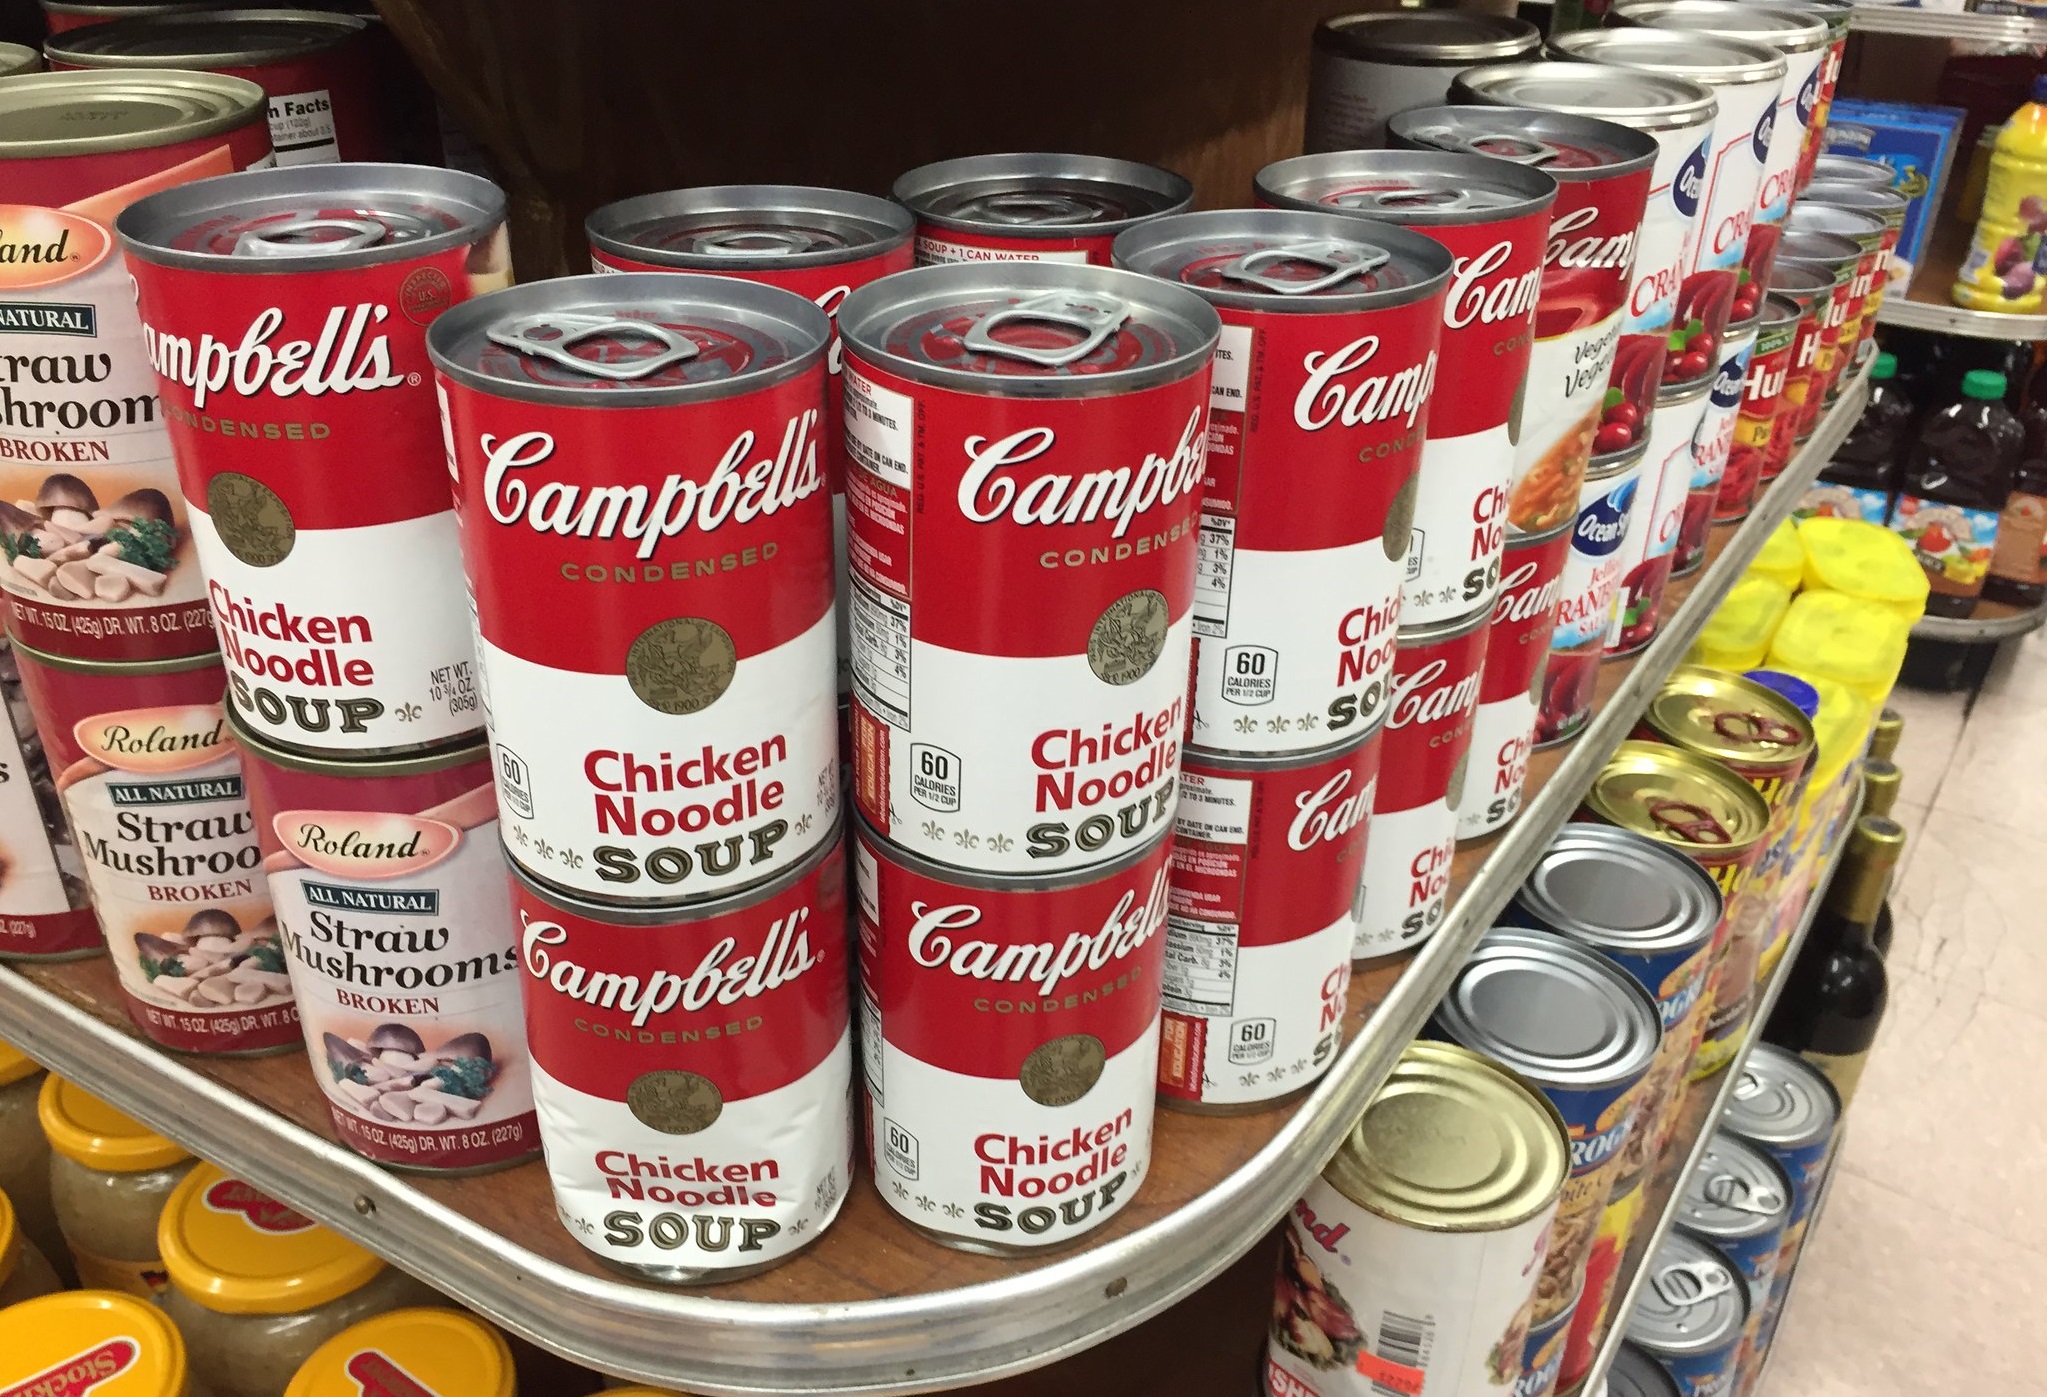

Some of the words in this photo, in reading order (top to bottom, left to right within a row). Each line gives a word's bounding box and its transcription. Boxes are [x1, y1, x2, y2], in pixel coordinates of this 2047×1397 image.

[284, 99, 329, 116] Facts
[924, 239, 948, 254] SOUP
[959, 249, 964, 258] 1
[967, 249, 991, 261] CAN
[1, 437, 110, 462] BROKEN
[1209, 534, 1229, 546] 37%
[1578, 514, 1618, 542] Ocean
[561, 542, 778, 583] CONDENSED
[1215, 548, 1228, 560] 1%
[1212, 563, 1227, 575] 3%
[1211, 578, 1226, 589] 4%
[104, 617, 125, 636] DR.
[125, 615, 149, 634] WT.
[150, 615, 160, 633] 8
[160, 612, 182, 633] OZ.
[210, 579, 373, 643] Chicken
[890, 616, 907, 633] 37%
[895, 636, 907, 648] 1%
[222, 628, 374, 686] Noodle
[894, 649, 907, 664] 3%
[1236, 653, 1265, 675] 60
[430, 666, 450, 685] NET
[453, 661, 472, 679] WT.
[1227, 676, 1271, 689] CALORIES
[231, 674, 384, 733] SOUP
[429, 686, 442, 702] 10
[449, 691, 478, 717] (305g)
[1226, 687, 1240, 697] PER
[1256, 688, 1271, 699] CUP
[103, 722, 222, 754] Roland
[1031, 696, 1181, 770] Chicken
[503, 753, 521, 785] 60
[584, 734, 786, 792] Chicken
[921, 751, 948, 780] 60
[1036, 740, 1177, 813] Noodle
[114, 786, 149, 802] ALL
[151, 782, 238, 801] NATURAL
[914, 775, 956, 796] CALORIES
[914, 786, 927, 798] PER
[928, 791, 940, 803] 1/2
[940, 795, 956, 806] CUP
[595, 780, 784, 837] Noodle
[1189, 793, 1197, 801] TO
[1205, 796, 1236, 806] MINUTES.
[1026, 776, 1176, 859] SOUP
[1187, 820, 1202, 830] DATE
[1204, 823, 1213, 831] ON
[1215, 824, 1228, 833] CAN
[1229, 826, 1244, 834] END.
[297, 824, 420, 859] Roland
[593, 819, 788, 885] SOUP
[149, 879, 252, 902] BROKEN
[308, 886, 340, 906] ALL
[341, 888, 432, 911] NATURAL
[310, 910, 448, 953] Straw
[282, 922, 518, 989] Mushrooms
[337, 988, 439, 1014] BROKEN
[973, 965, 1142, 1013] CONDENSED
[262, 1014, 281, 1028] WT.
[282, 1010, 290, 1023] 8
[574, 1016, 763, 1044] CONDENSED
[1241, 1023, 1266, 1042] 60
[419, 1137, 438, 1151] DR.
[440, 1136, 460, 1150] WT.
[462, 1136, 470, 1148] 8
[471, 1130, 490, 1147] OZ.
[491, 1122, 523, 1147] (227g)
[891, 1126, 909, 1154] 60
[974, 1106, 1132, 1165] Chicken
[595, 1150, 779, 1182] Chicken
[980, 1143, 1128, 1198] Noodle
[606, 1176, 776, 1207] Noodle
[974, 1171, 1128, 1234] SOUP
[603, 1211, 781, 1252] SOUP
